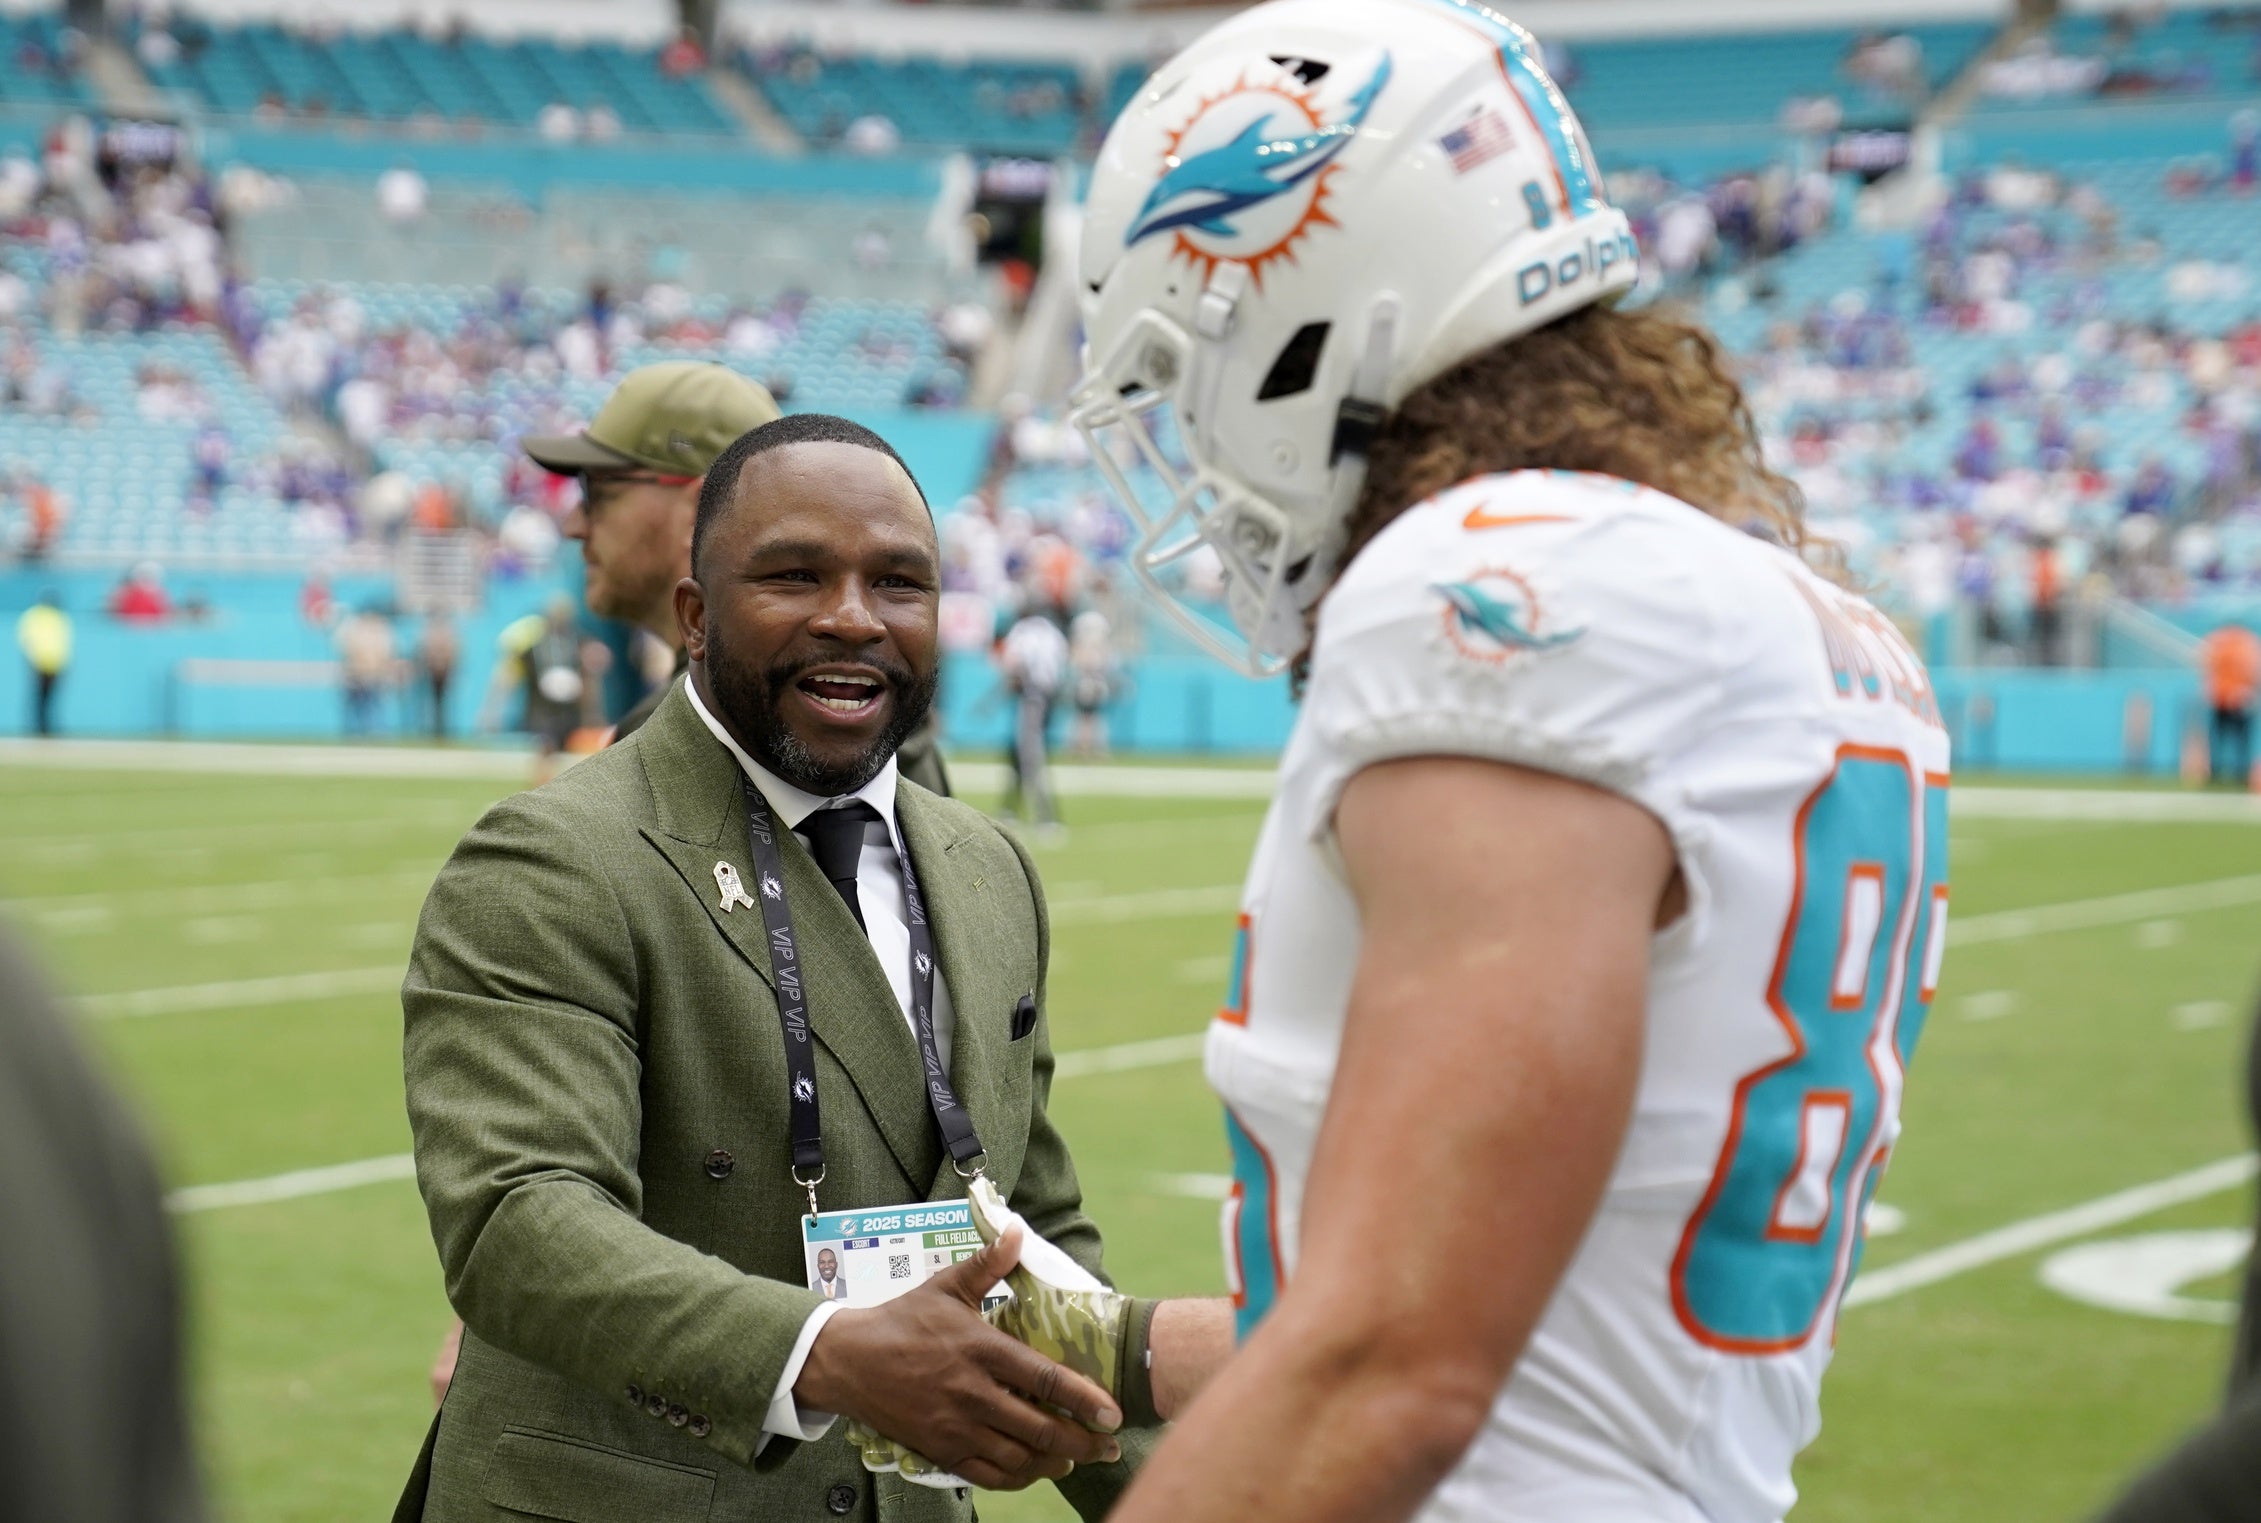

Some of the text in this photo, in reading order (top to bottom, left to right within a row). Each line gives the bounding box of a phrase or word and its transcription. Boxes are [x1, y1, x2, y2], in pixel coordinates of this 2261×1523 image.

[1516, 227, 1638, 307] Dolph
[751, 811, 772, 845] VIP
[723, 884, 743, 897] NFL
[908, 894, 927, 925] VIP
[771, 926, 807, 1043] VIP VIP VIP
[920, 1005, 956, 1111] VIP VIP VIP
[862, 1210, 968, 1232] 2025 SEASON
[935, 1233, 950, 1246] FULL
[950, 1232, 967, 1244] FIELD
